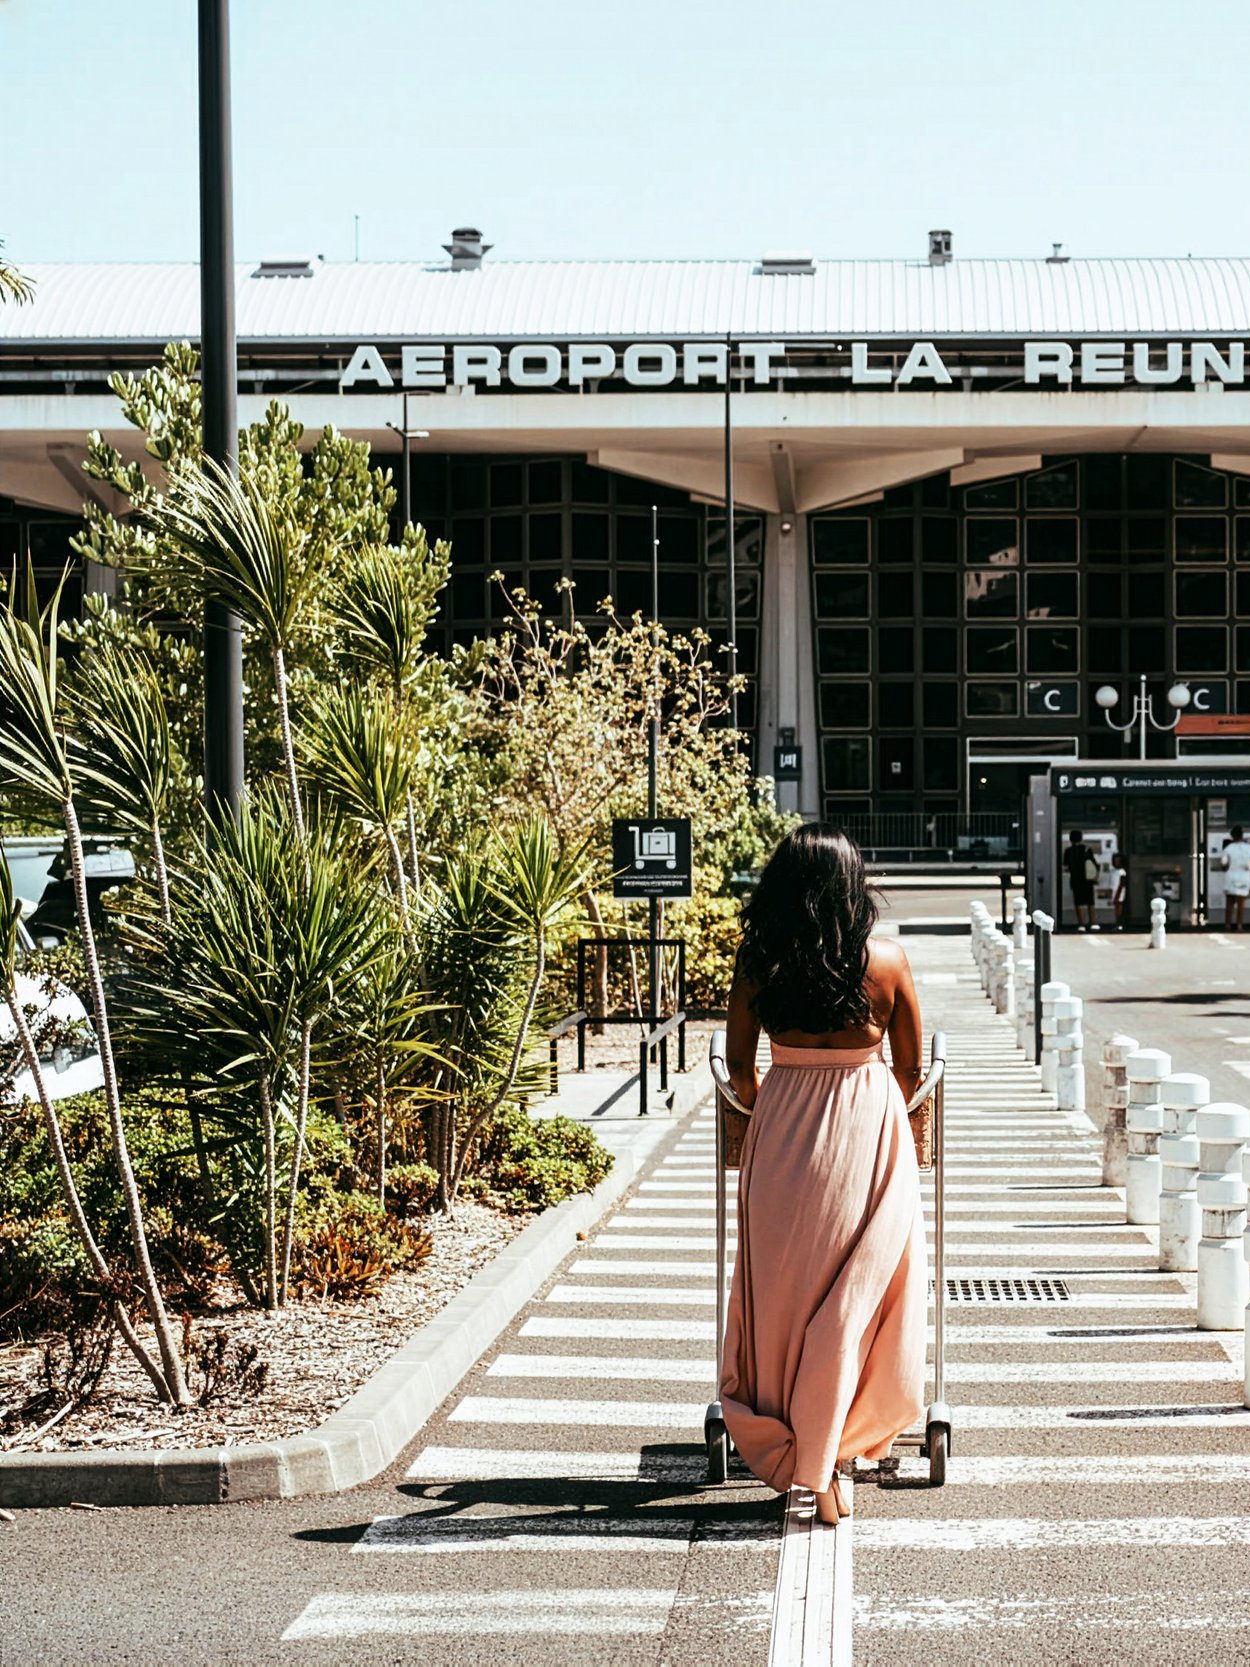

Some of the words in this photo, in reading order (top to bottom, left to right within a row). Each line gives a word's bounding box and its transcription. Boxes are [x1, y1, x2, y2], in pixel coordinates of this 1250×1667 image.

[339, 343, 785, 388] AEROPORT
[851, 342, 953, 385] LA
[1044, 689, 1061, 711] C
[1193, 688, 1210, 710] C
